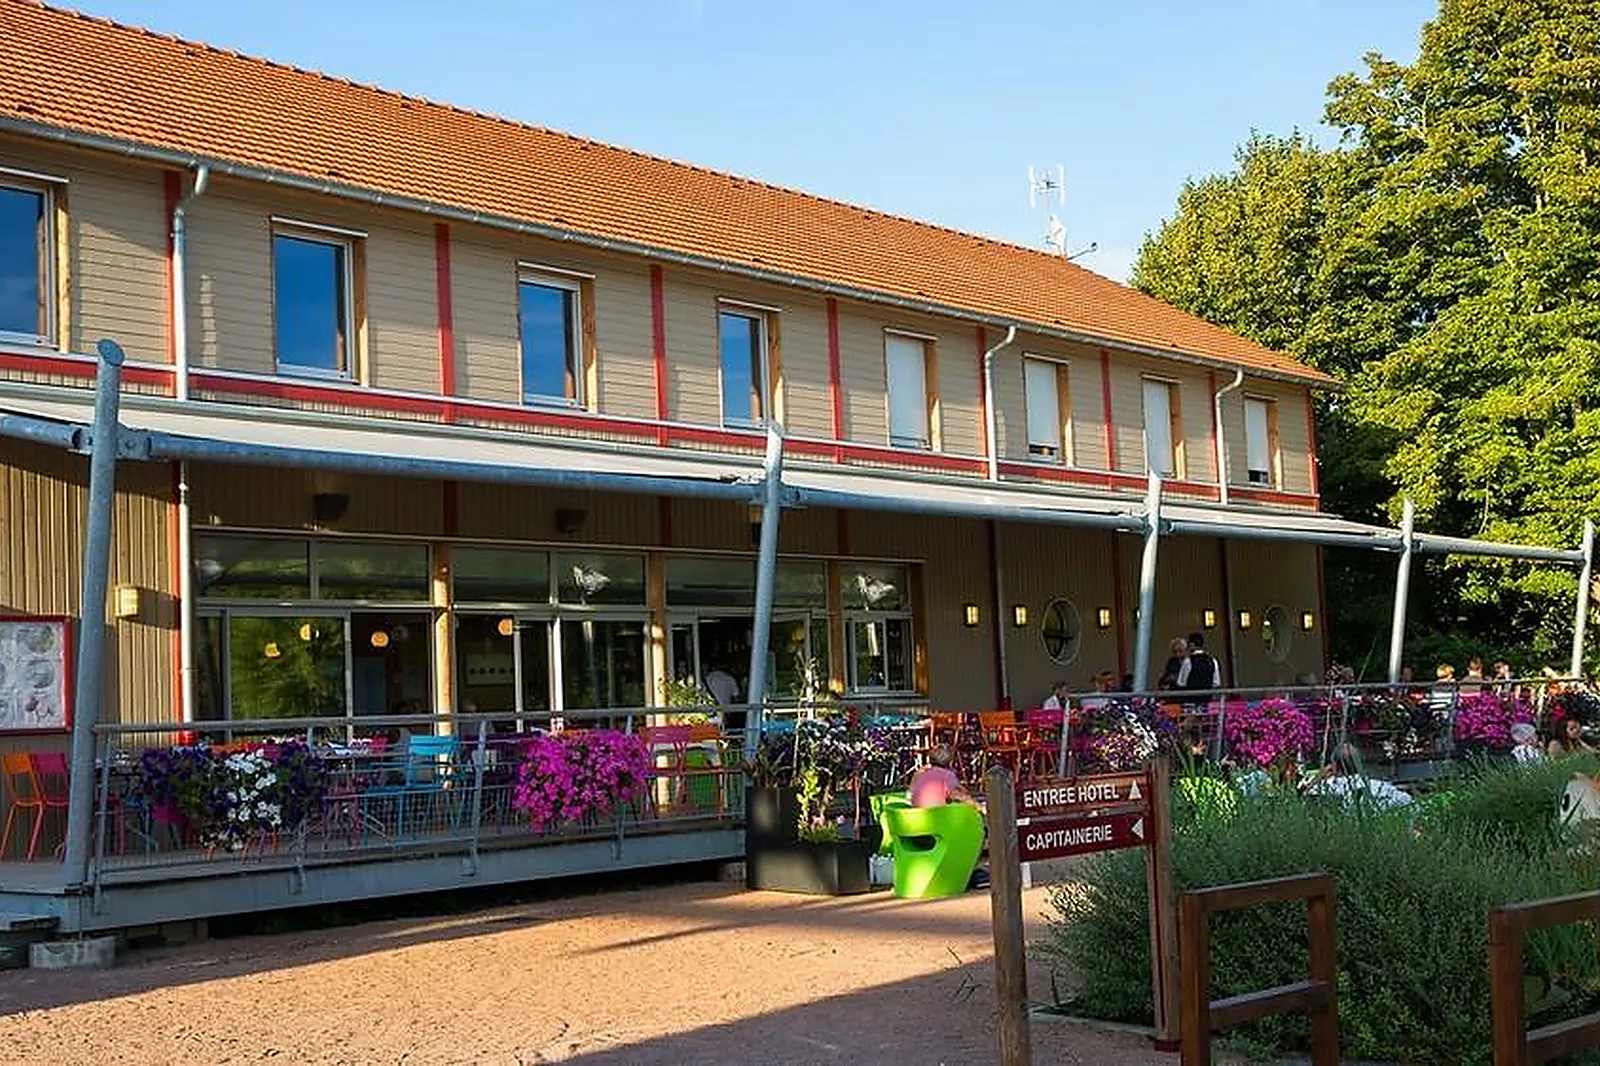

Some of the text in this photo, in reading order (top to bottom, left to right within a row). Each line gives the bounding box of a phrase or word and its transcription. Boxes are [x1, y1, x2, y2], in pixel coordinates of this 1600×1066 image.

[1023, 783, 1120, 808] ENTREE HOTEL
[1026, 824, 1113, 850] CAPITAINERIE
